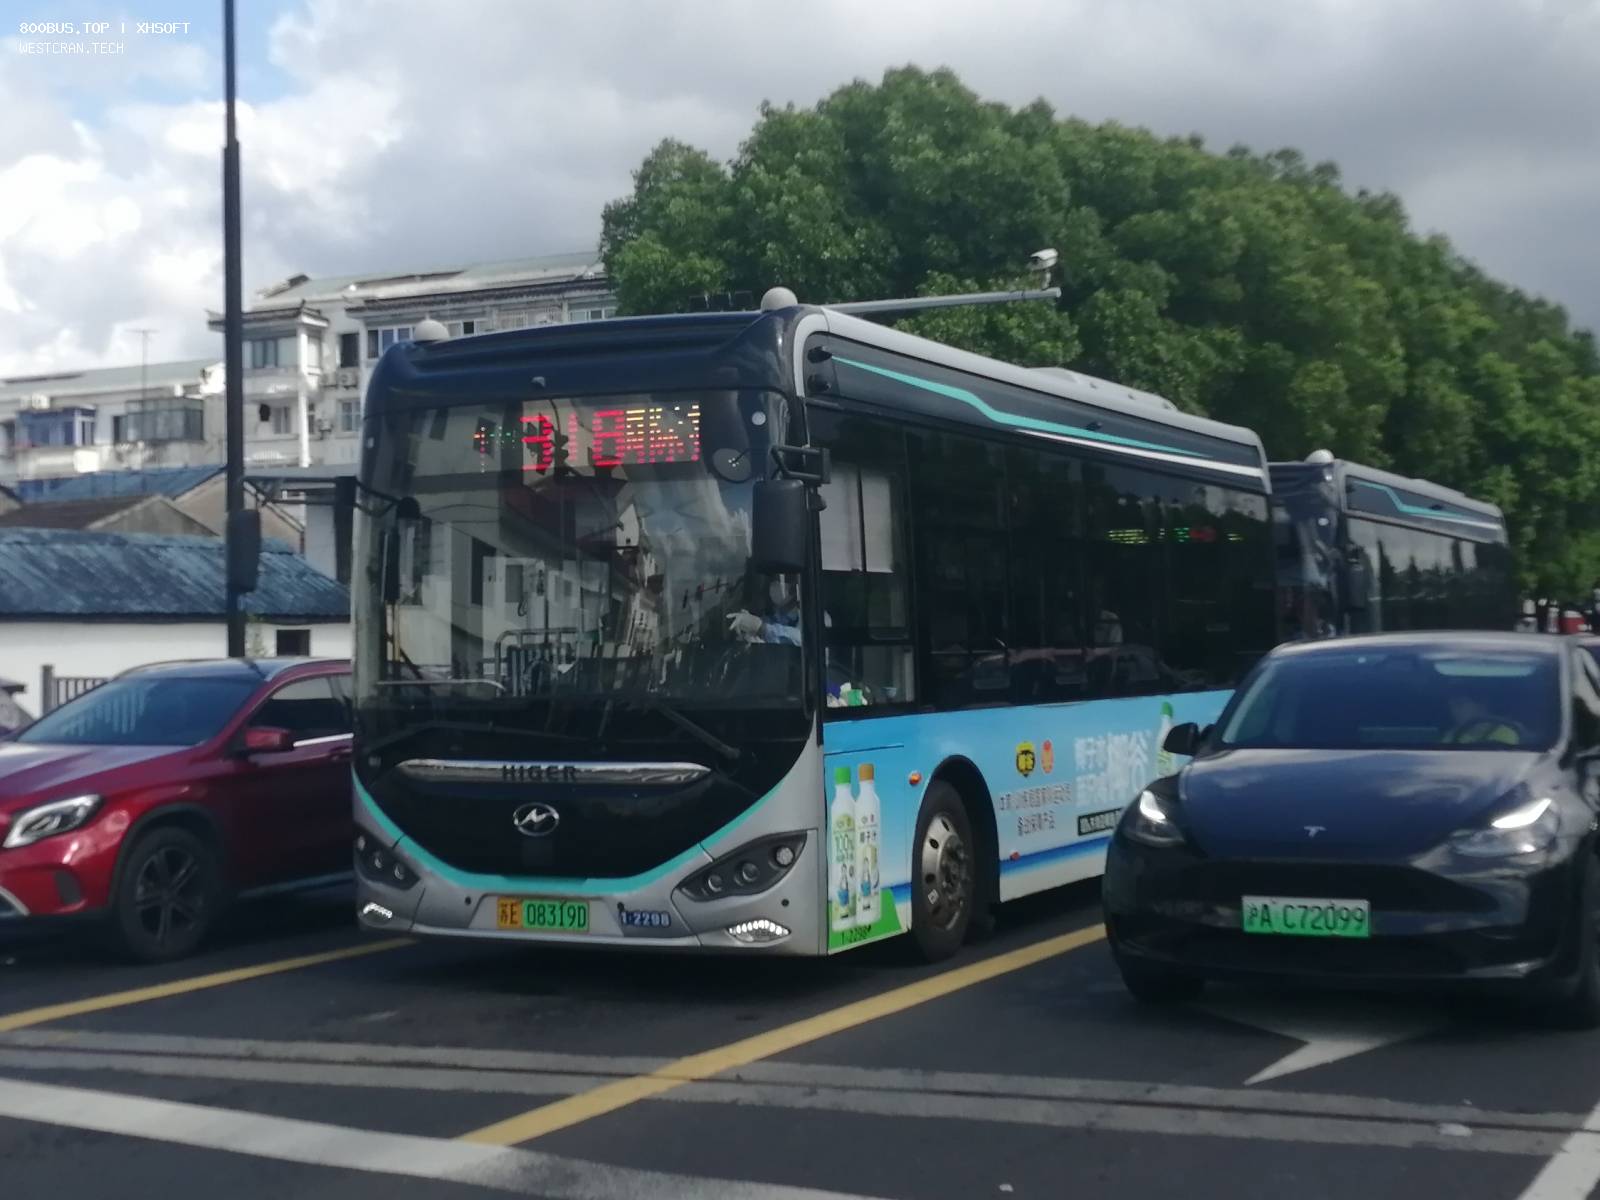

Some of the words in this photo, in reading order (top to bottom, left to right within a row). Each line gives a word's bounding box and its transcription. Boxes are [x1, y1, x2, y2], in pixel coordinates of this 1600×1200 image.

[502, 765, 577, 781] HIGER
[527, 904, 587, 928] 08319D
[1282, 904, 1366, 930] C72099
